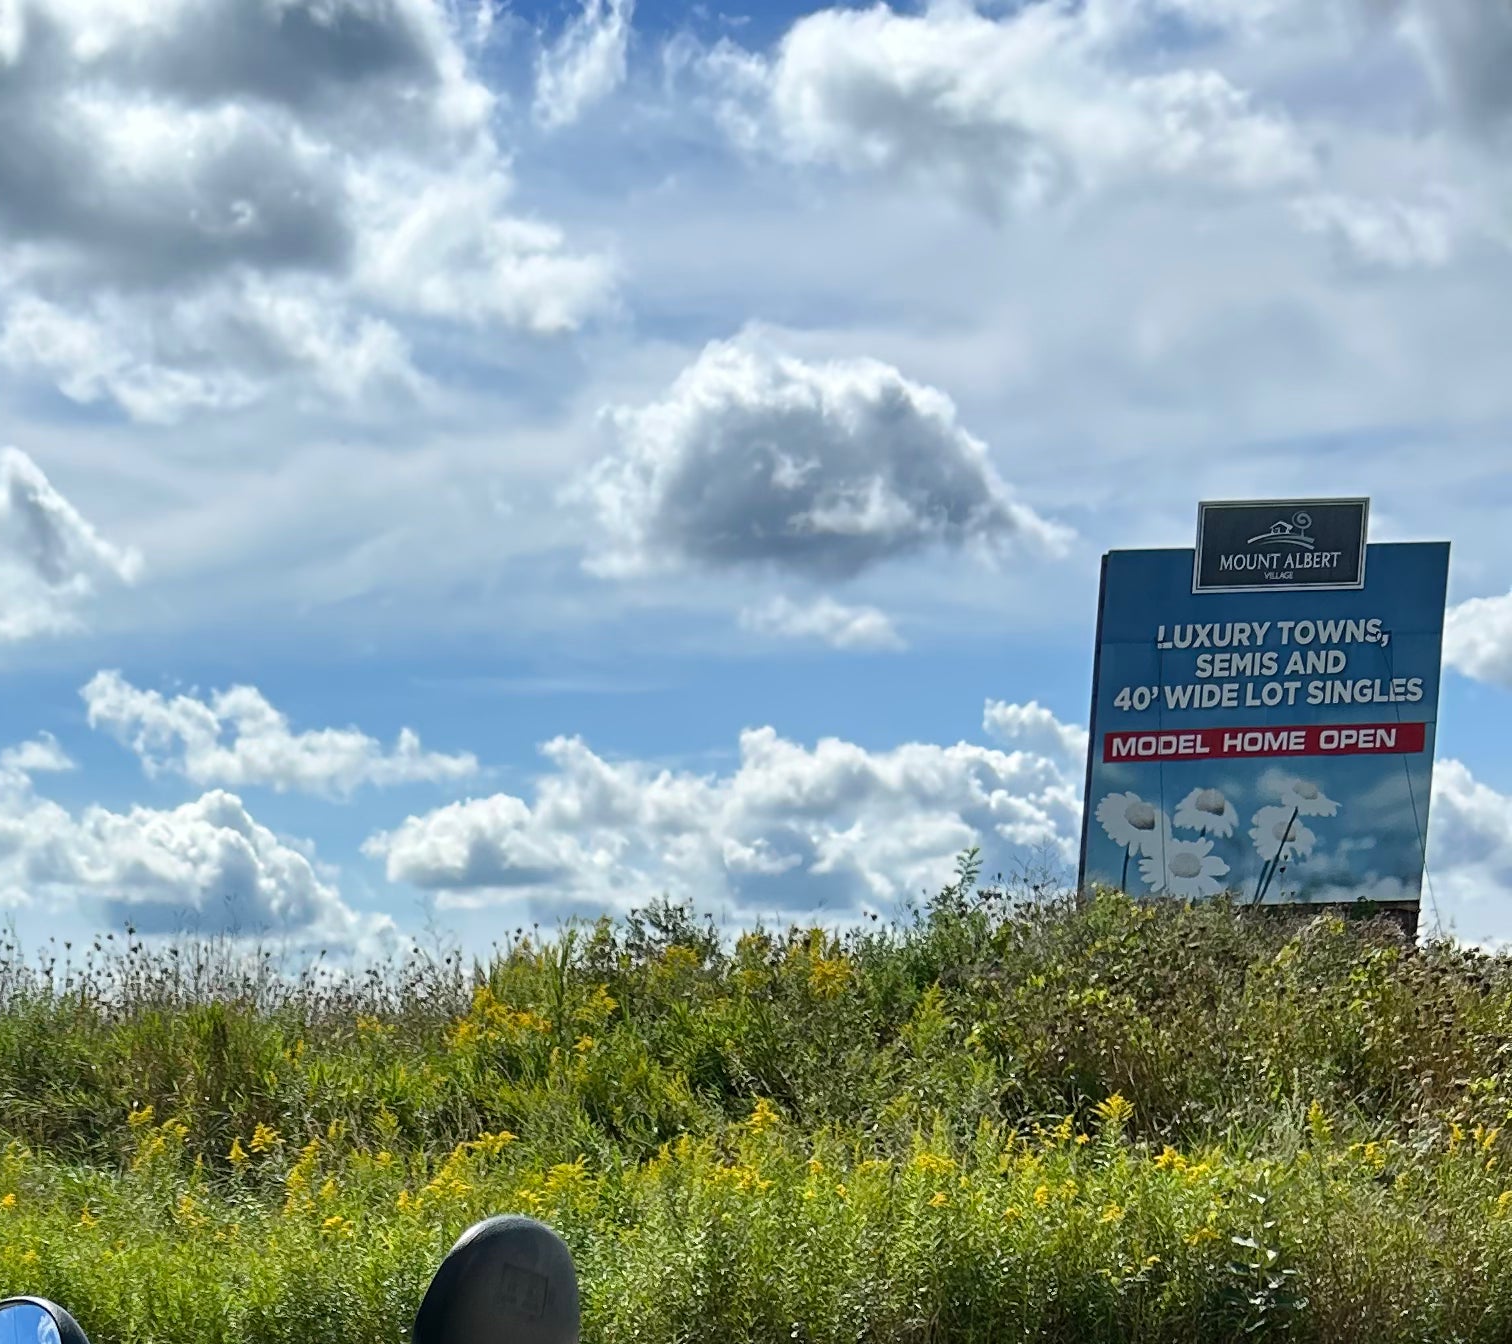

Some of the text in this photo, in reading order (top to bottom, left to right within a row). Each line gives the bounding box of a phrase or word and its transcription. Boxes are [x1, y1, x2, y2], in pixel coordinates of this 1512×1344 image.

[1219, 551, 1342, 571] MOUNT ALBERT
[1264, 571, 1294, 580] VILLAGE
[1156, 617, 1391, 650] LUXURY TOWNS,
[1194, 648, 1347, 679] SEMIS AND
[1164, 684, 1240, 709] WIDE
[1245, 682, 1300, 707] LOT
[1306, 677, 1424, 704] SINGLES
[1111, 727, 1397, 758] MODEL HOME OPEN
